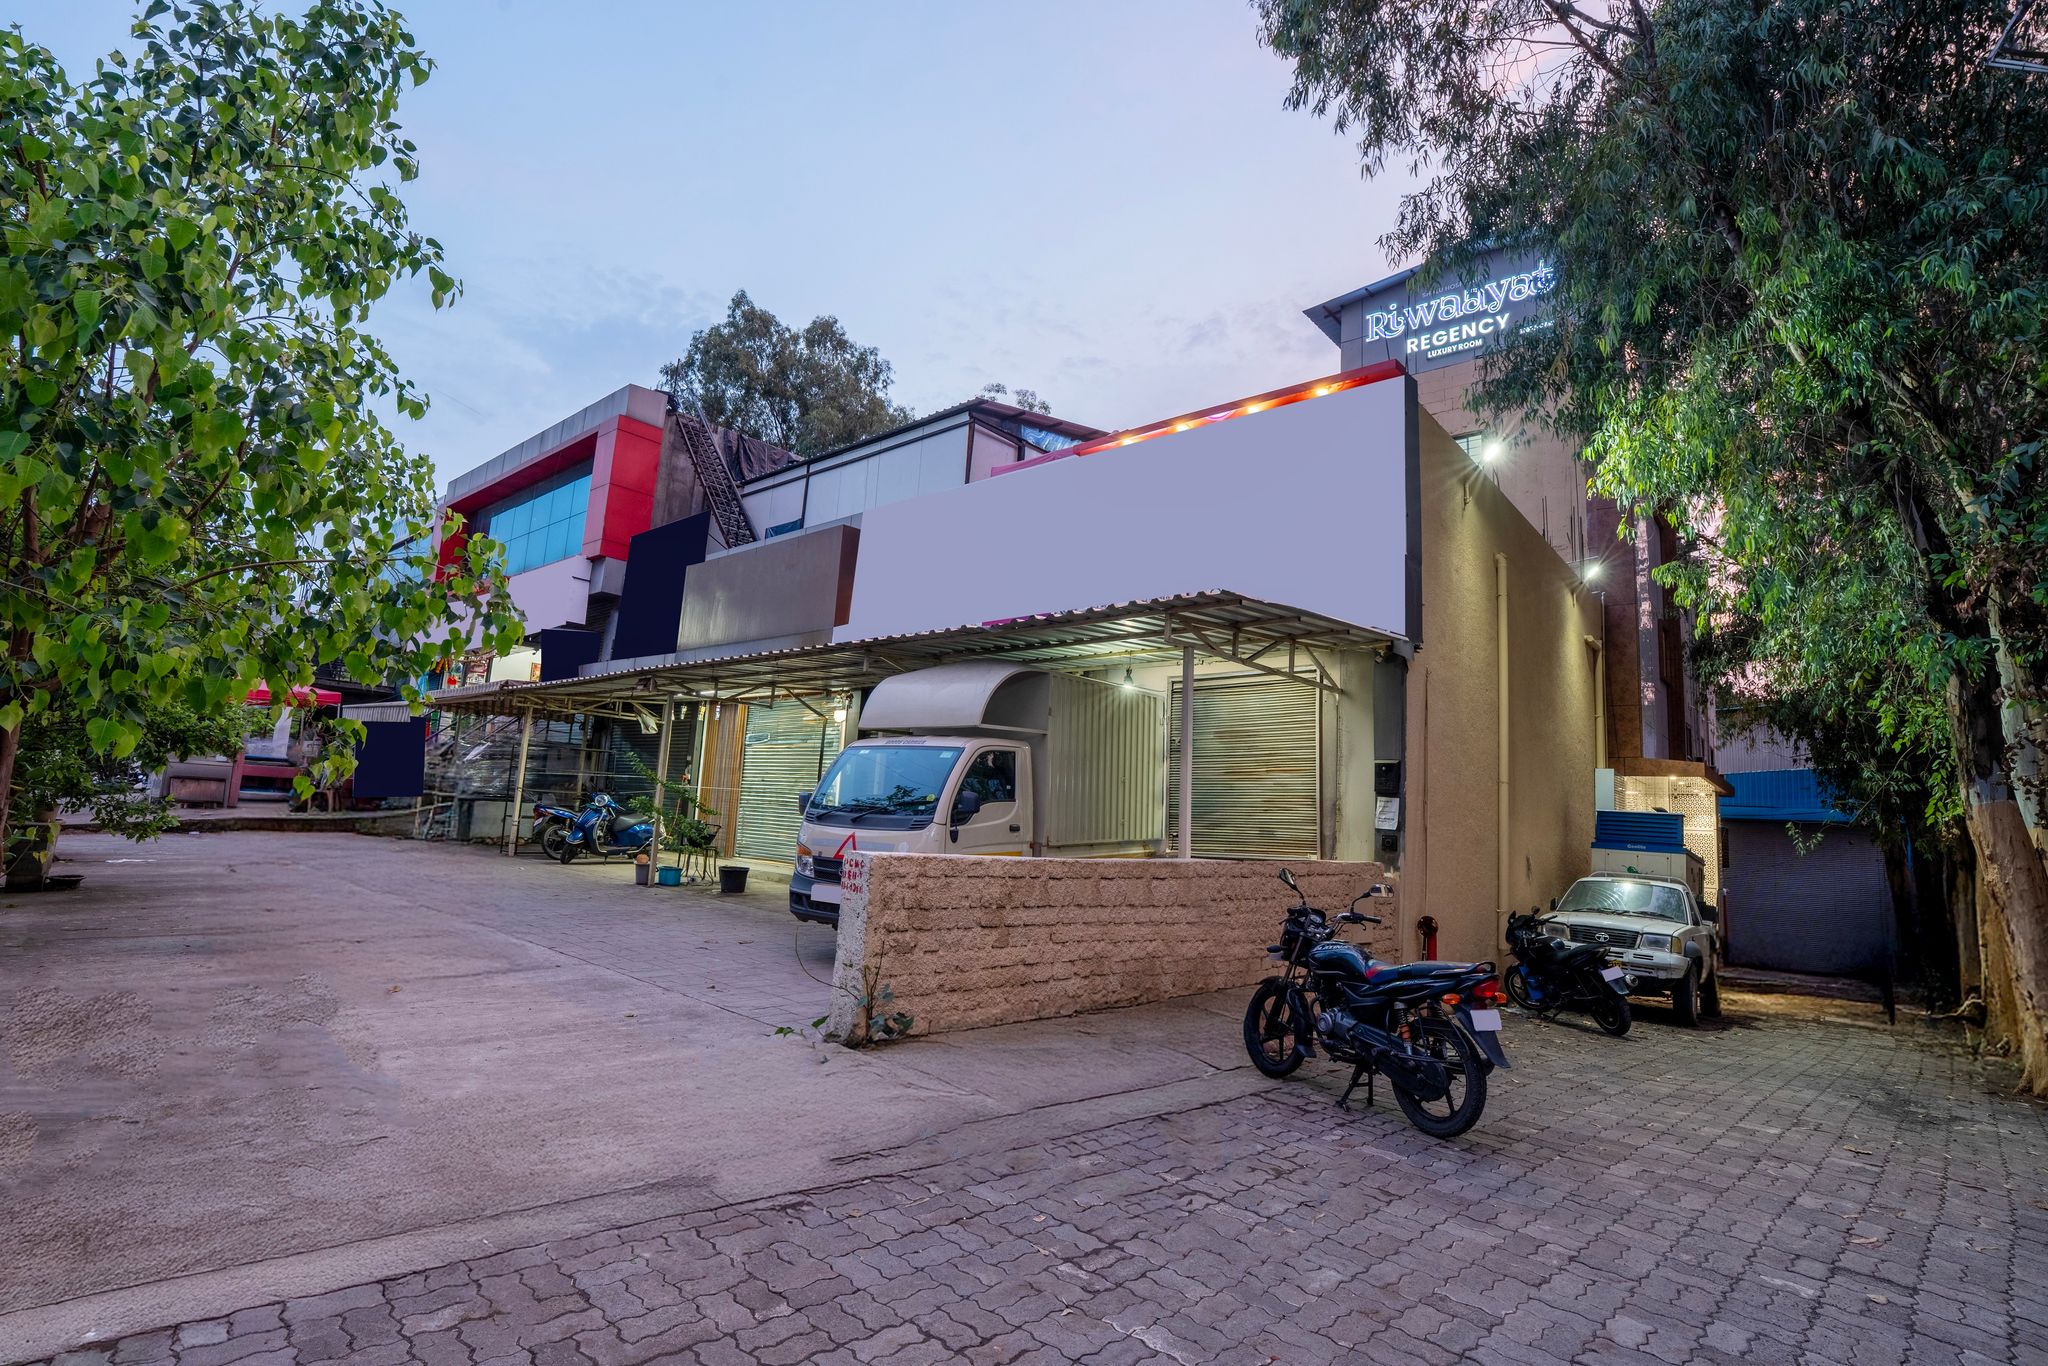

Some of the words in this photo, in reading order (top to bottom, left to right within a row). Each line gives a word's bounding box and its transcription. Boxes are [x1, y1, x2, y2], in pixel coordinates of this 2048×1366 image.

[1407, 313, 1510, 354] REGENCY
[1427, 344, 1459, 359] LUXURY
[1458, 338, 1483, 354] ROOM
